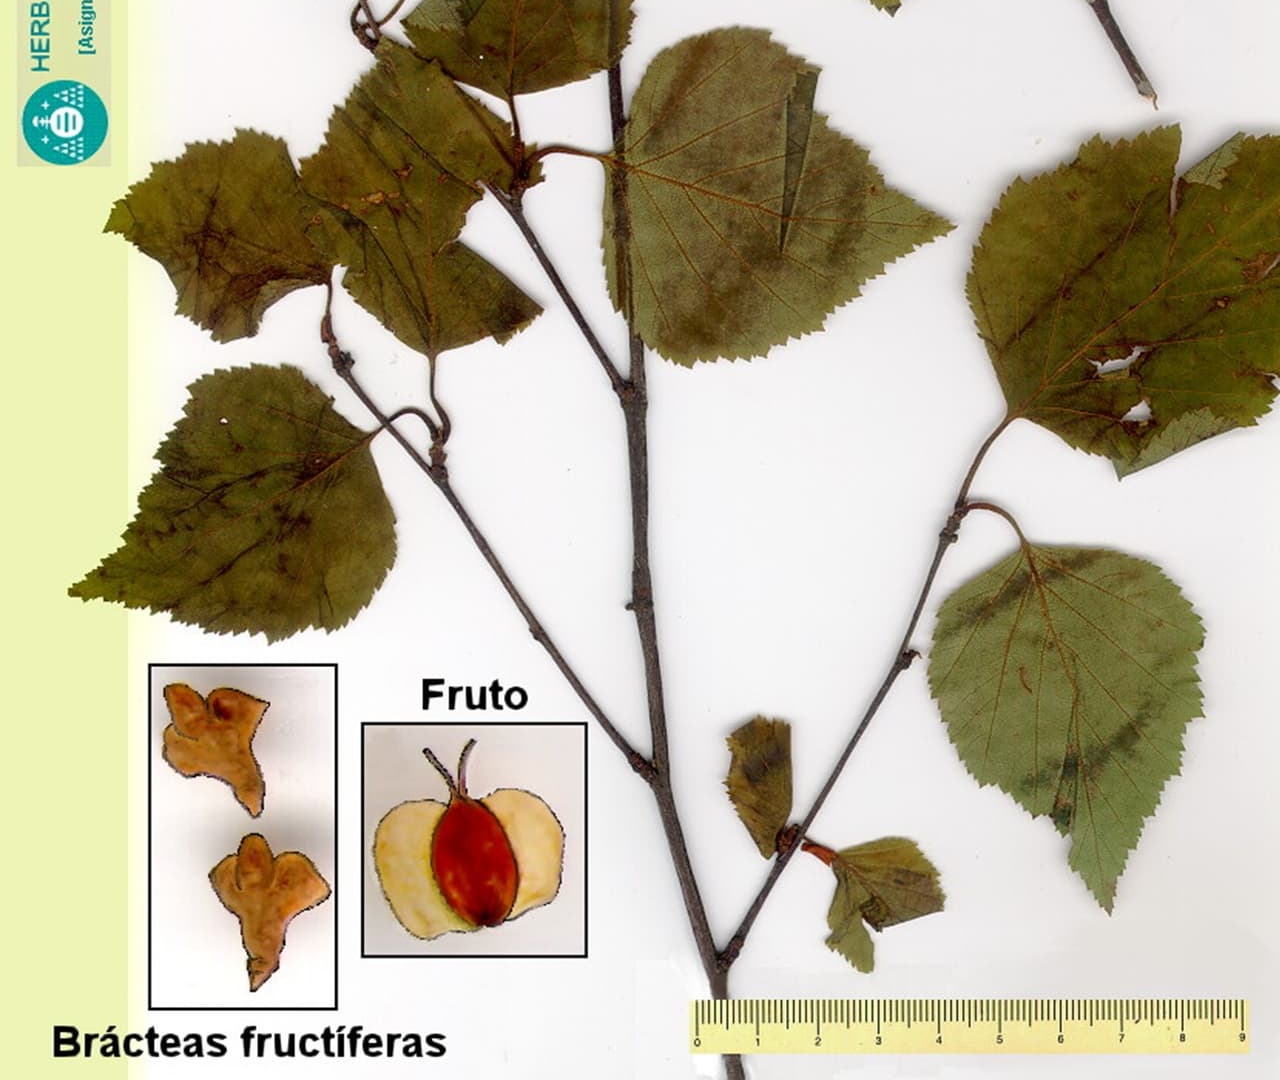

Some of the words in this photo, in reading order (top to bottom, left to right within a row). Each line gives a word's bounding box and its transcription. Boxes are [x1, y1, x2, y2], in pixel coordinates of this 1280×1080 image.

[693, 1036, 702, 1048] 0
[755, 1035, 760, 1047] 1
[814, 1035, 822, 1047] 2
[875, 1035, 883, 1046] 3
[935, 1034, 943, 1045] 4
[996, 1034, 1004, 1045] 5
[1057, 1034, 1065, 1044] 6
[1118, 1033, 1126, 1044] 7
[1179, 1033, 1186, 1043] 8
[1238, 1032, 1246, 1043] 9
